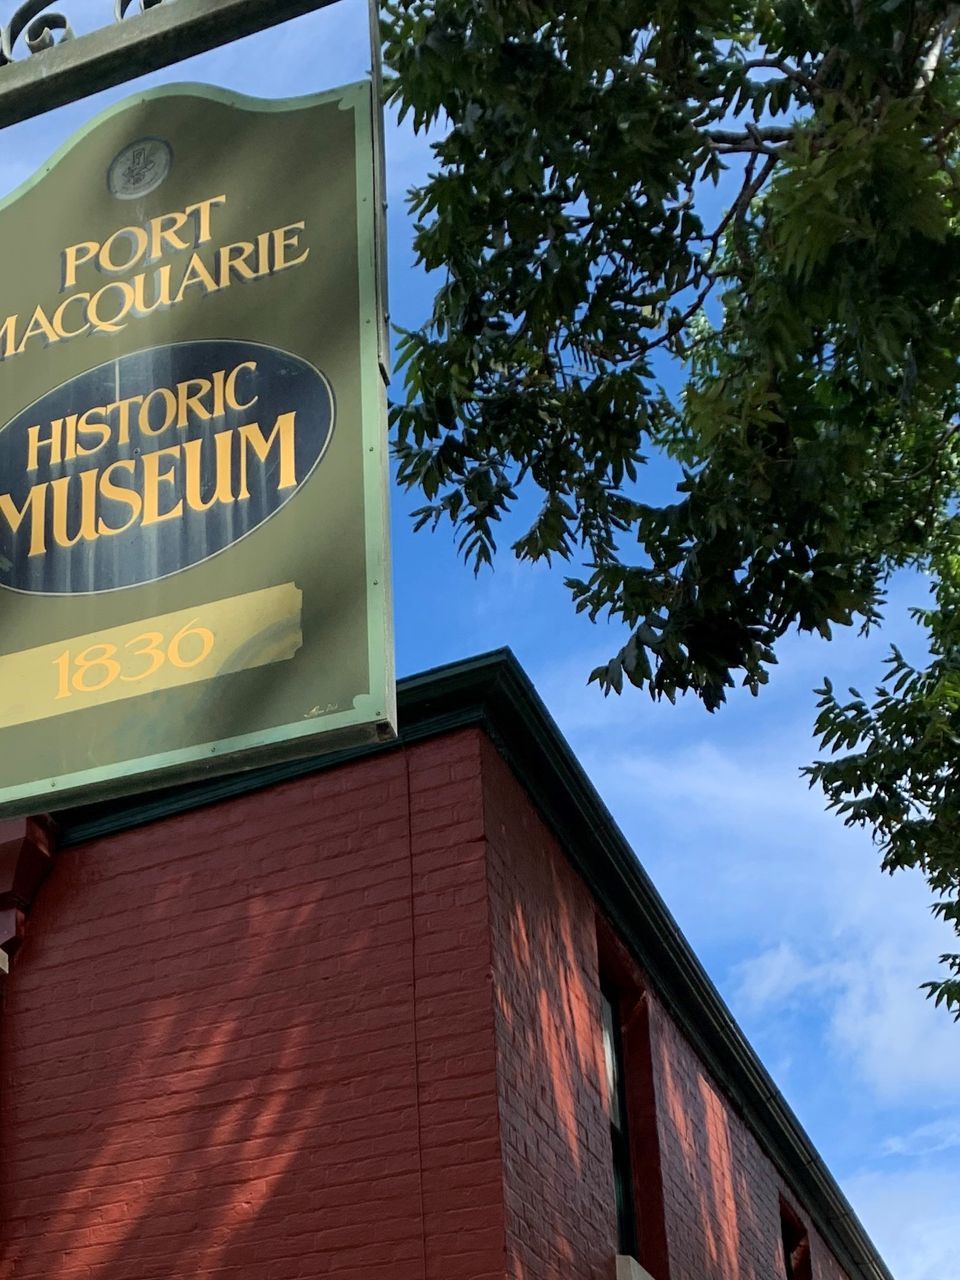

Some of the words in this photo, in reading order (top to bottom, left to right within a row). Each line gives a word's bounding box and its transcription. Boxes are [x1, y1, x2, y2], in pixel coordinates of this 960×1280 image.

[64, 196, 227, 291] PORT
[26, 362, 258, 472] HISTORIC
[53, 619, 215, 701] 1836
